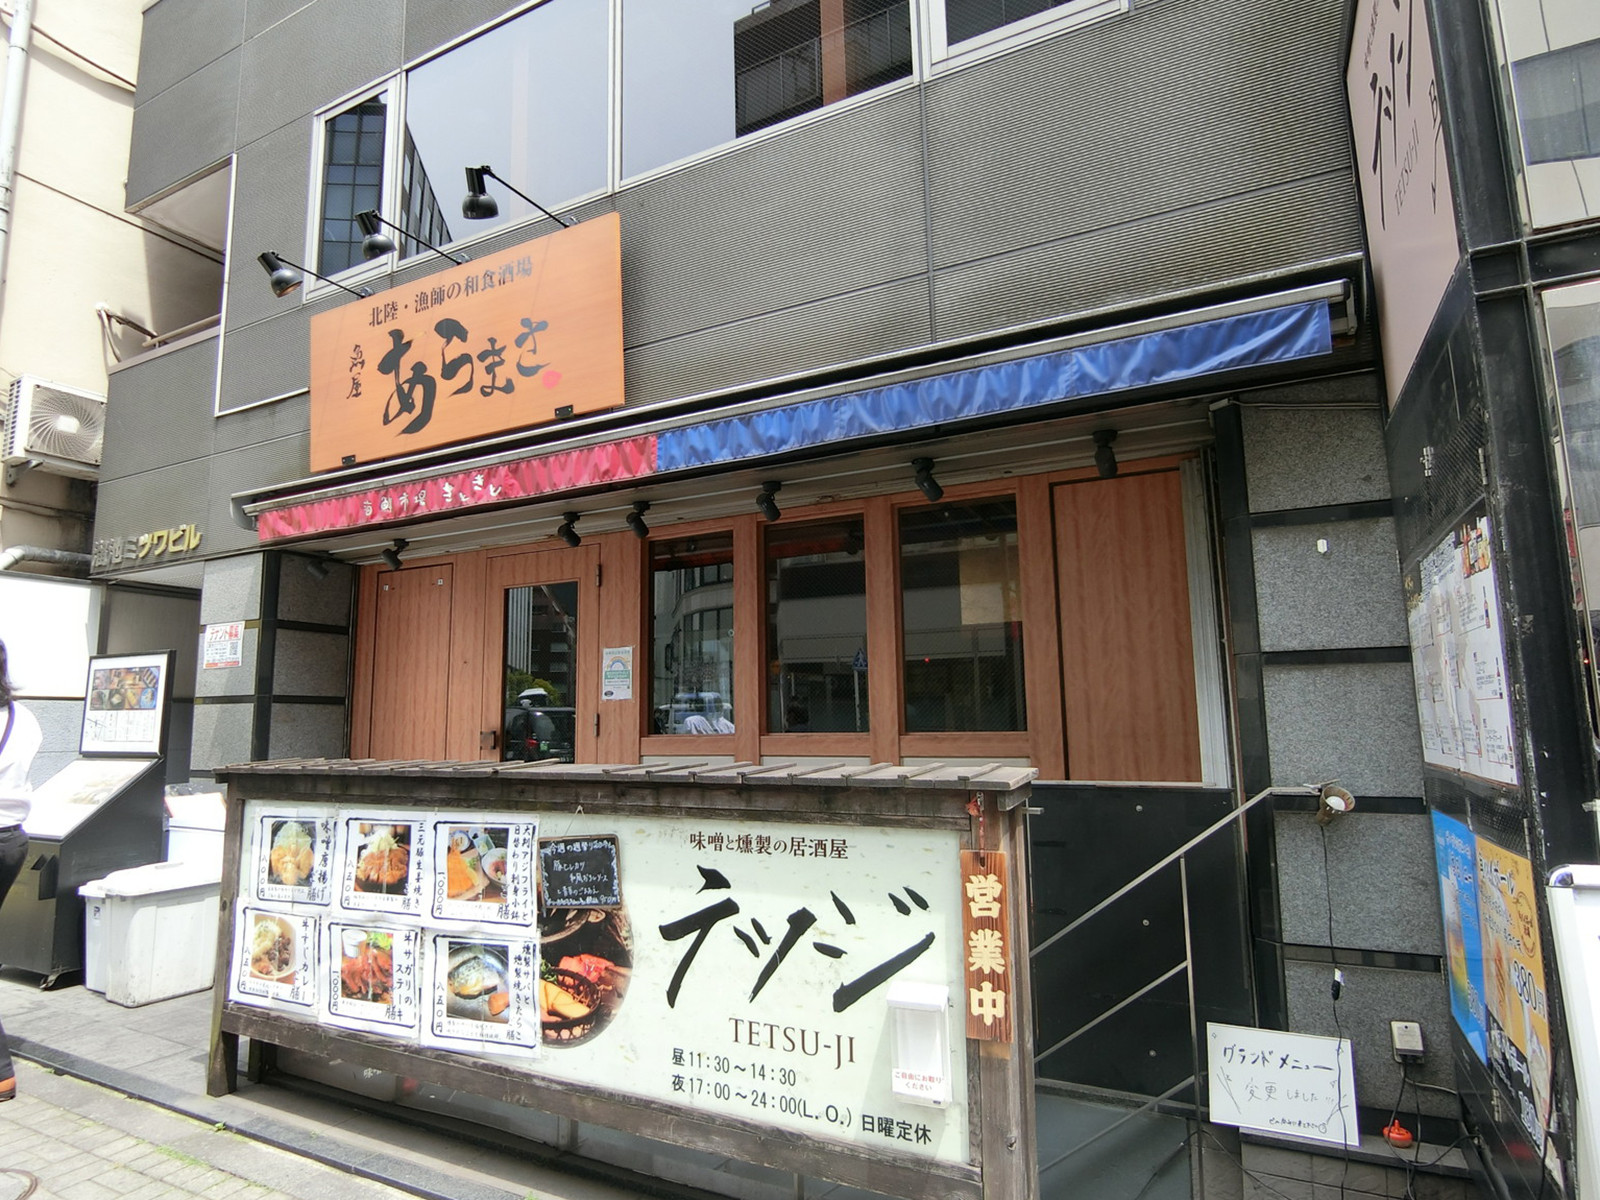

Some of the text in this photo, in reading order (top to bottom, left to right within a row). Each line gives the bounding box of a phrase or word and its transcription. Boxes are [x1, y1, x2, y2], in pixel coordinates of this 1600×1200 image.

[1395, 120, 1420, 216] TETSU-JI
[369, 256, 533, 328] 北陸・漁師の和食酒場
[377, 318, 551, 437] あらまさ
[316, 819, 332, 901] 味噌唐揚げ
[413, 822, 425, 909] 三元豚生姜焼き
[689, 832, 848, 860] 味噌と燻製の居酒屋
[299, 918, 310, 1001] 牛すじカレー
[404, 932, 413, 1006] 牛サガリの
[658, 864, 935, 1013] テツジ
[965, 873, 1006, 1026] 営業中
[395, 964, 403, 1021] ステーキ
[728, 1017, 856, 1070] TETSU-JI
[905, 1081, 932, 1091] ください
[861, 1114, 932, 1145] 日曜定休
